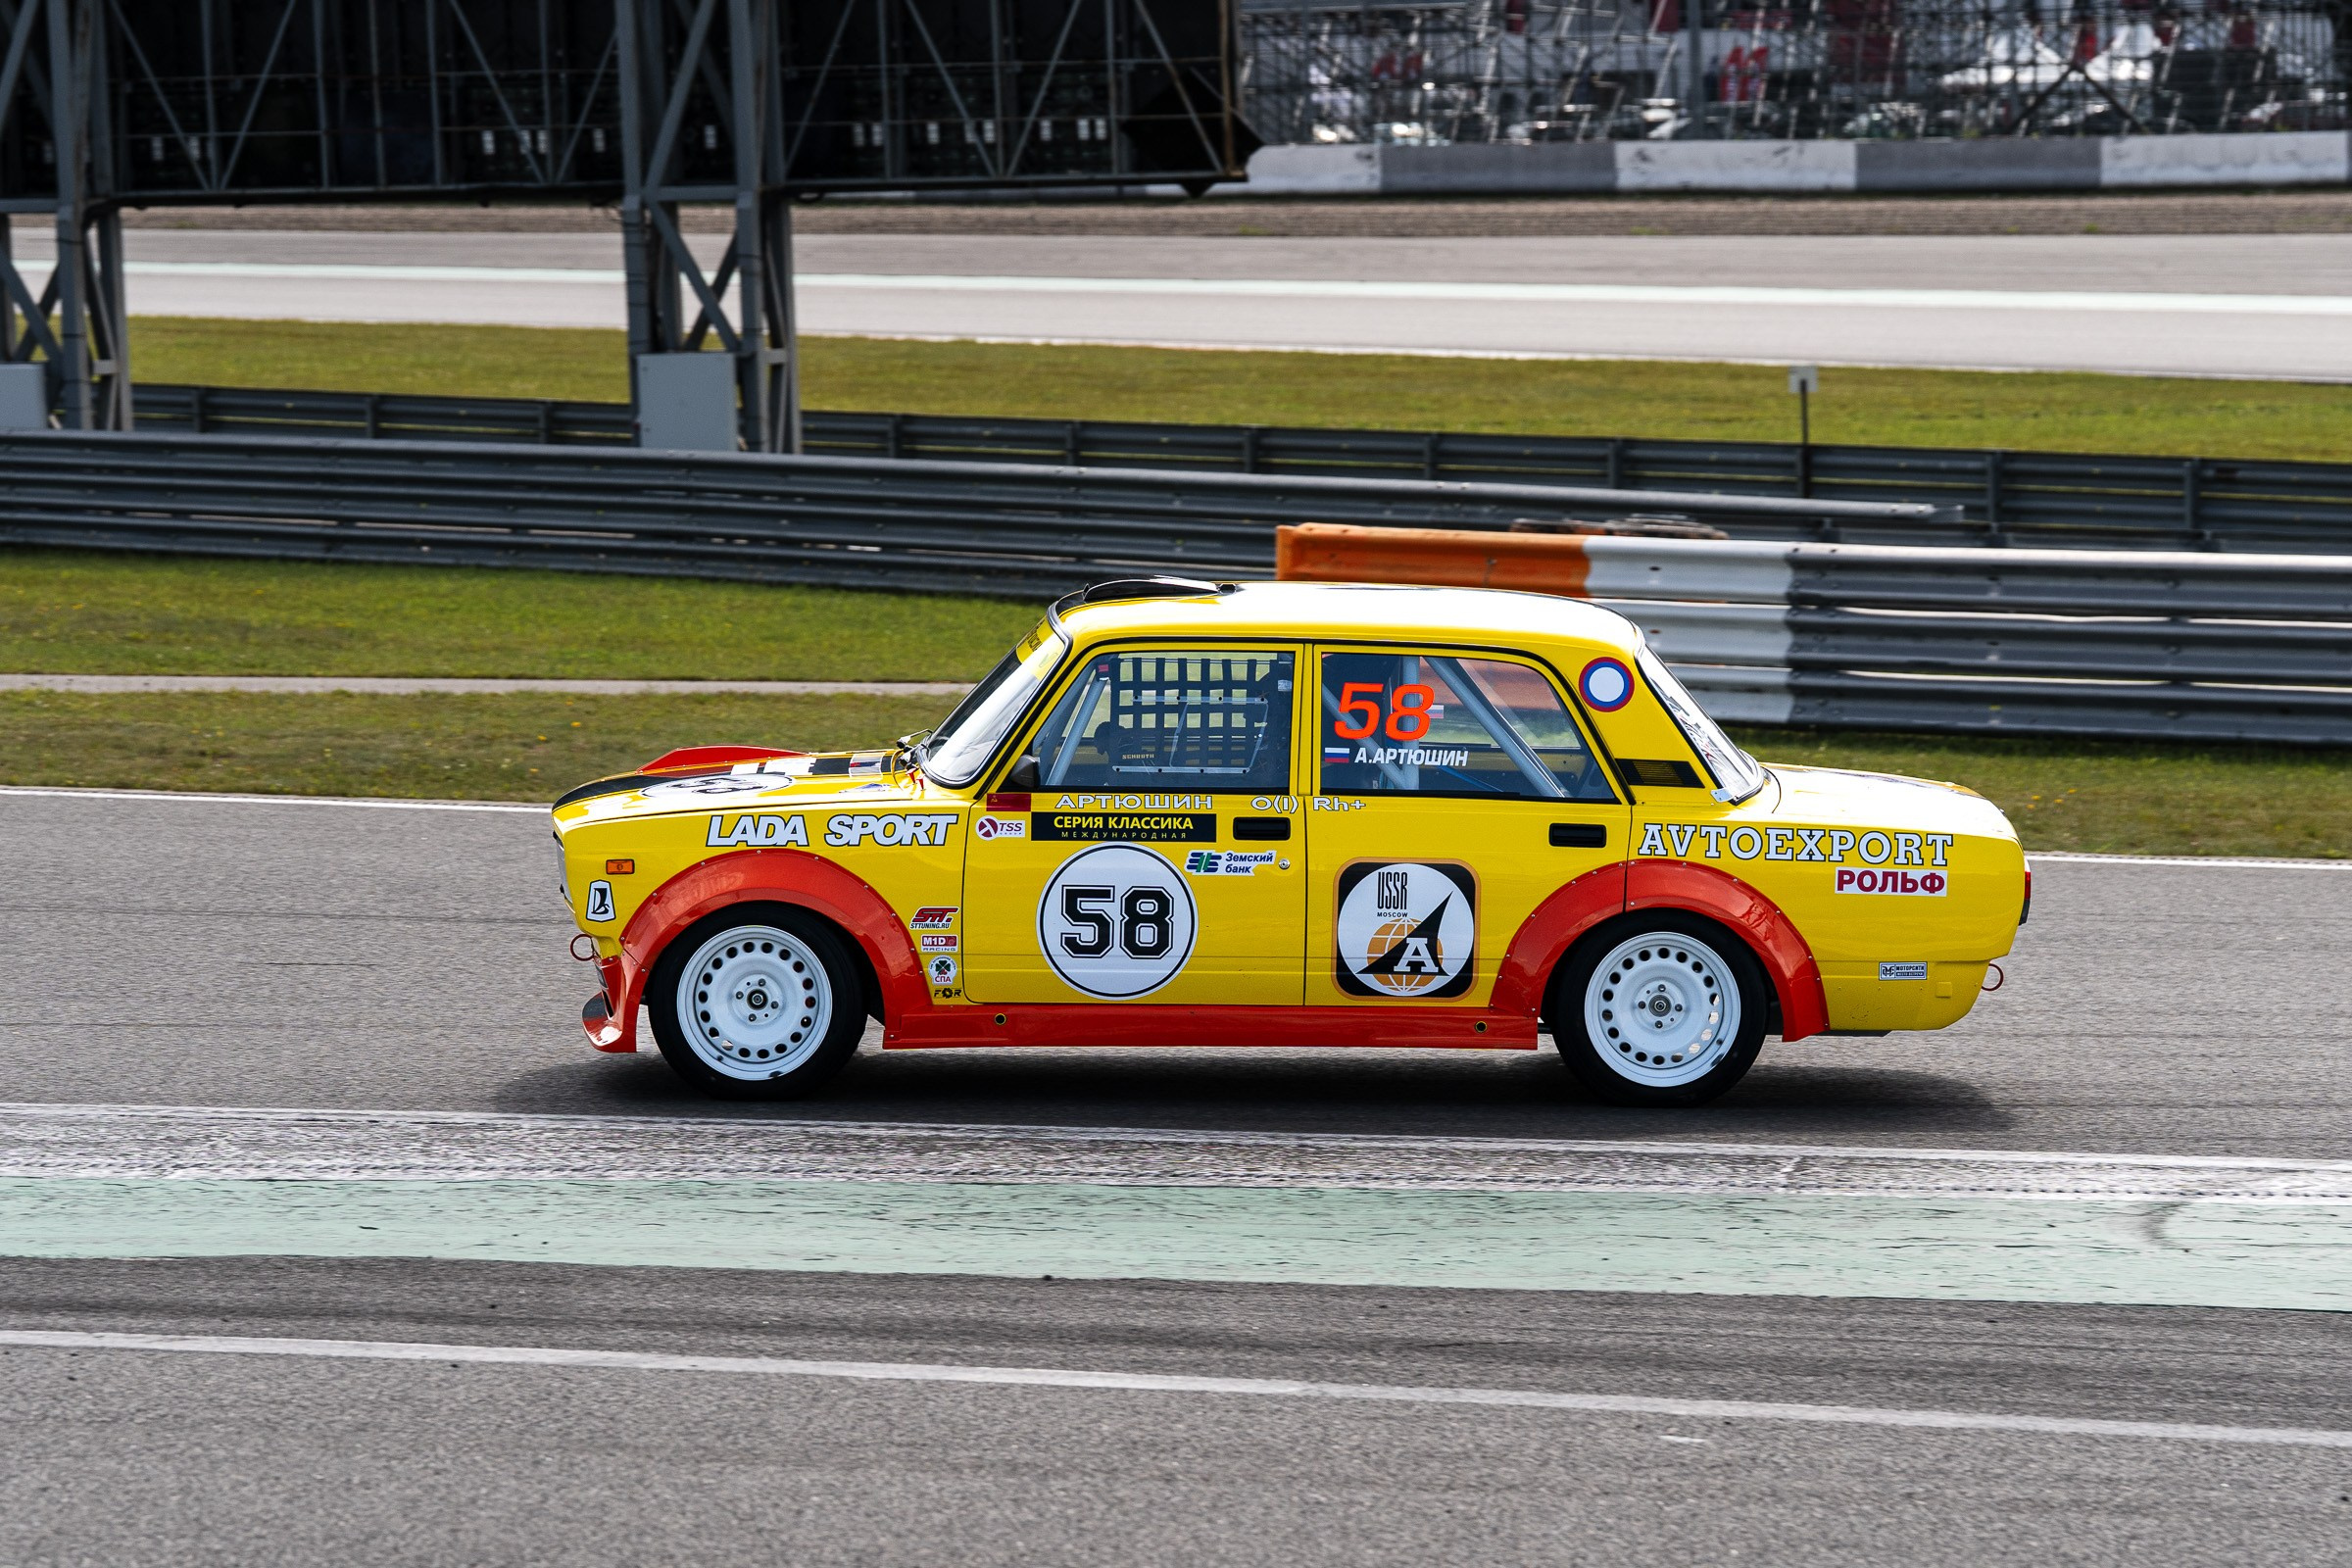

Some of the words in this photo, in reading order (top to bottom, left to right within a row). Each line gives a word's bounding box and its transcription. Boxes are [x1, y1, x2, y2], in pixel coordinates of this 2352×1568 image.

[1334, 682, 1435, 741] 58
[1354, 747, 1469, 766] А.АРТЮШИН
[1054, 795, 1212, 809] АРТЮШИН
[1312, 797, 1366, 811] Rh+
[706, 814, 809, 847] LADA
[824, 813, 958, 847] SPORT
[999, 822, 1023, 832] TSS
[1054, 815, 1103, 829] СЕРИЯ
[1108, 816, 1194, 830] КЛАССИКА
[1638, 823, 1953, 866] AVTOEXPORT
[1225, 852, 1274, 862] Земский
[1225, 863, 1251, 874] банк
[1377, 871, 1408, 909] USSR
[1837, 869, 1945, 894] РОЛЬФ
[1060, 884, 1174, 959] 58
[923, 936, 946, 946] M1D
